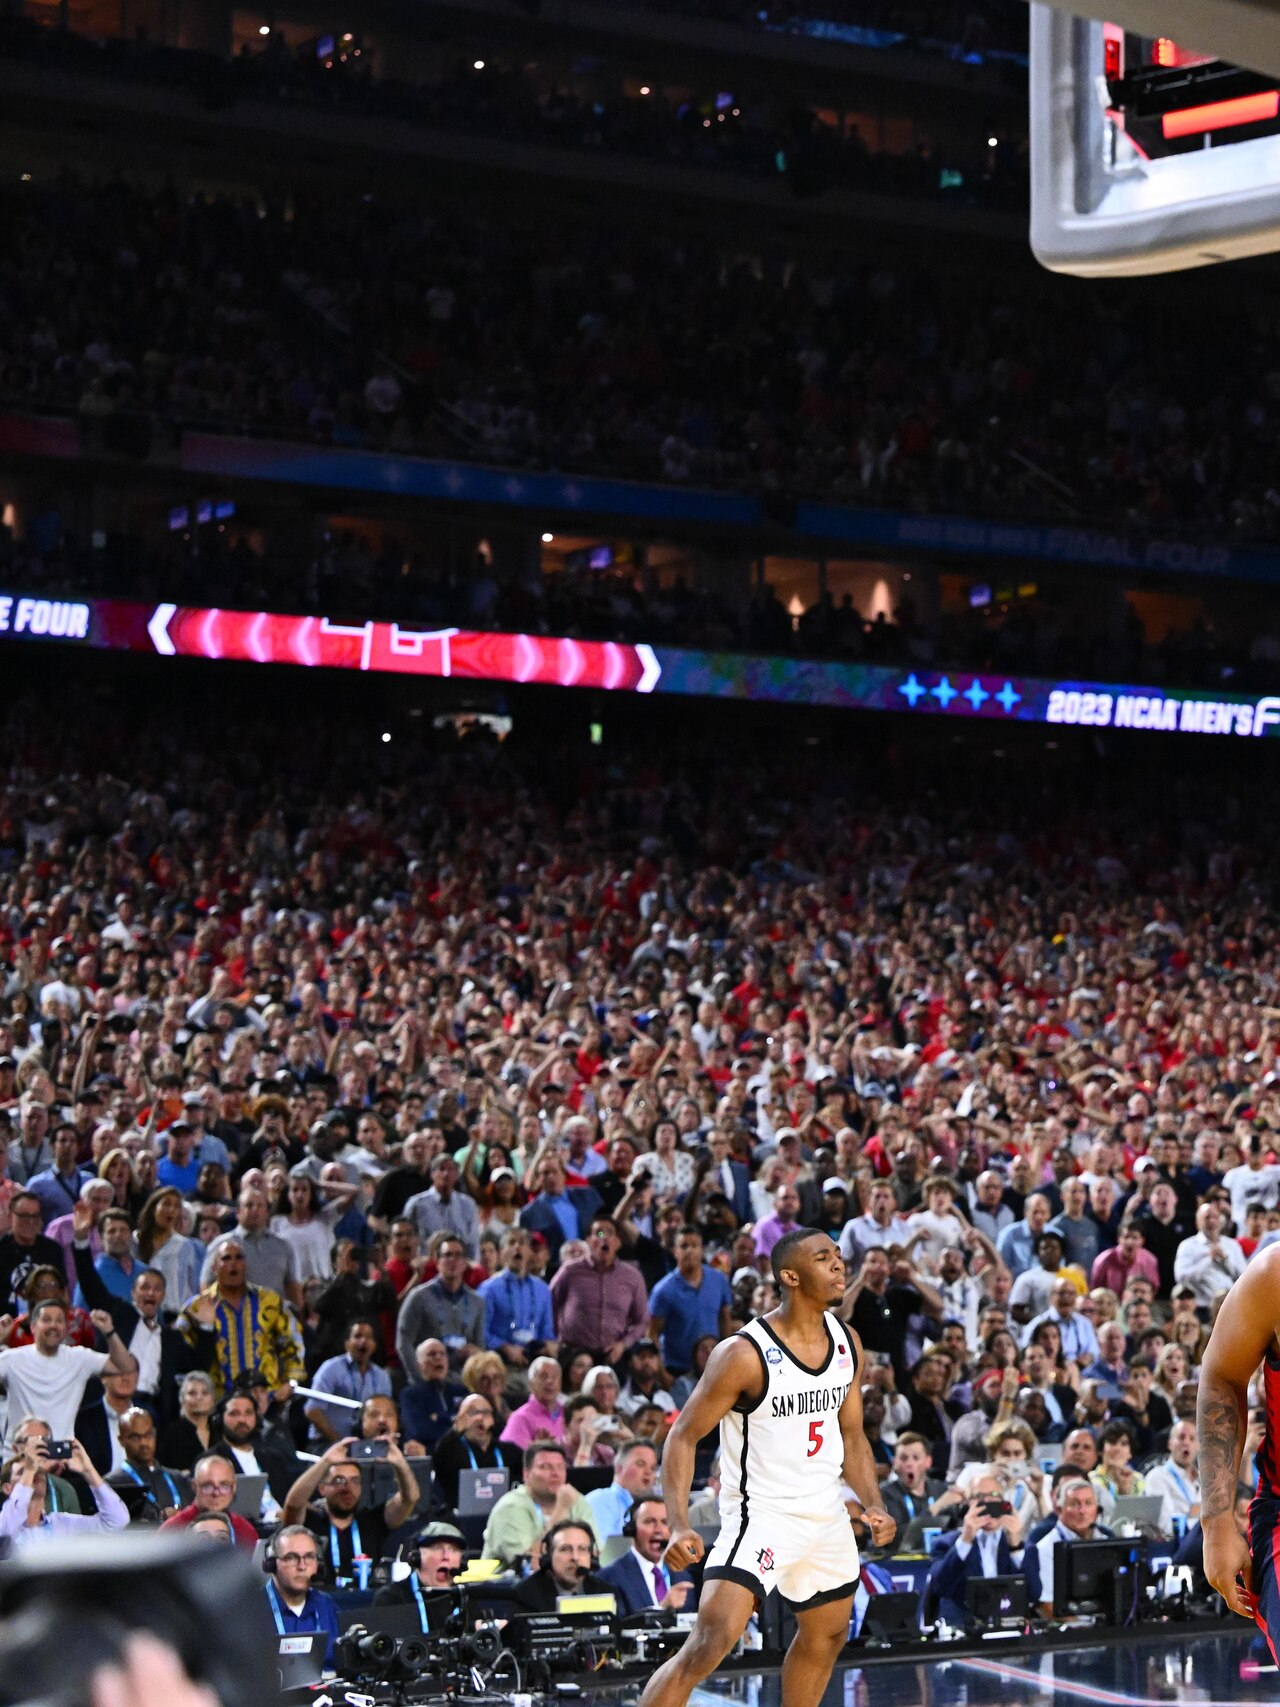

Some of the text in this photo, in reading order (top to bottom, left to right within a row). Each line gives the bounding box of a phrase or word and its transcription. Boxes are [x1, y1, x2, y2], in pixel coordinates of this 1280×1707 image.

[14, 598, 89, 638] FOUR
[1046, 690, 1113, 726] 2023
[1114, 695, 1180, 730] NCAA
[1180, 700, 1255, 736] MEN'S
[772, 1394, 795, 1418] SAN
[797, 1388, 830, 1416] DIEGO
[807, 1420, 824, 1457] 5
